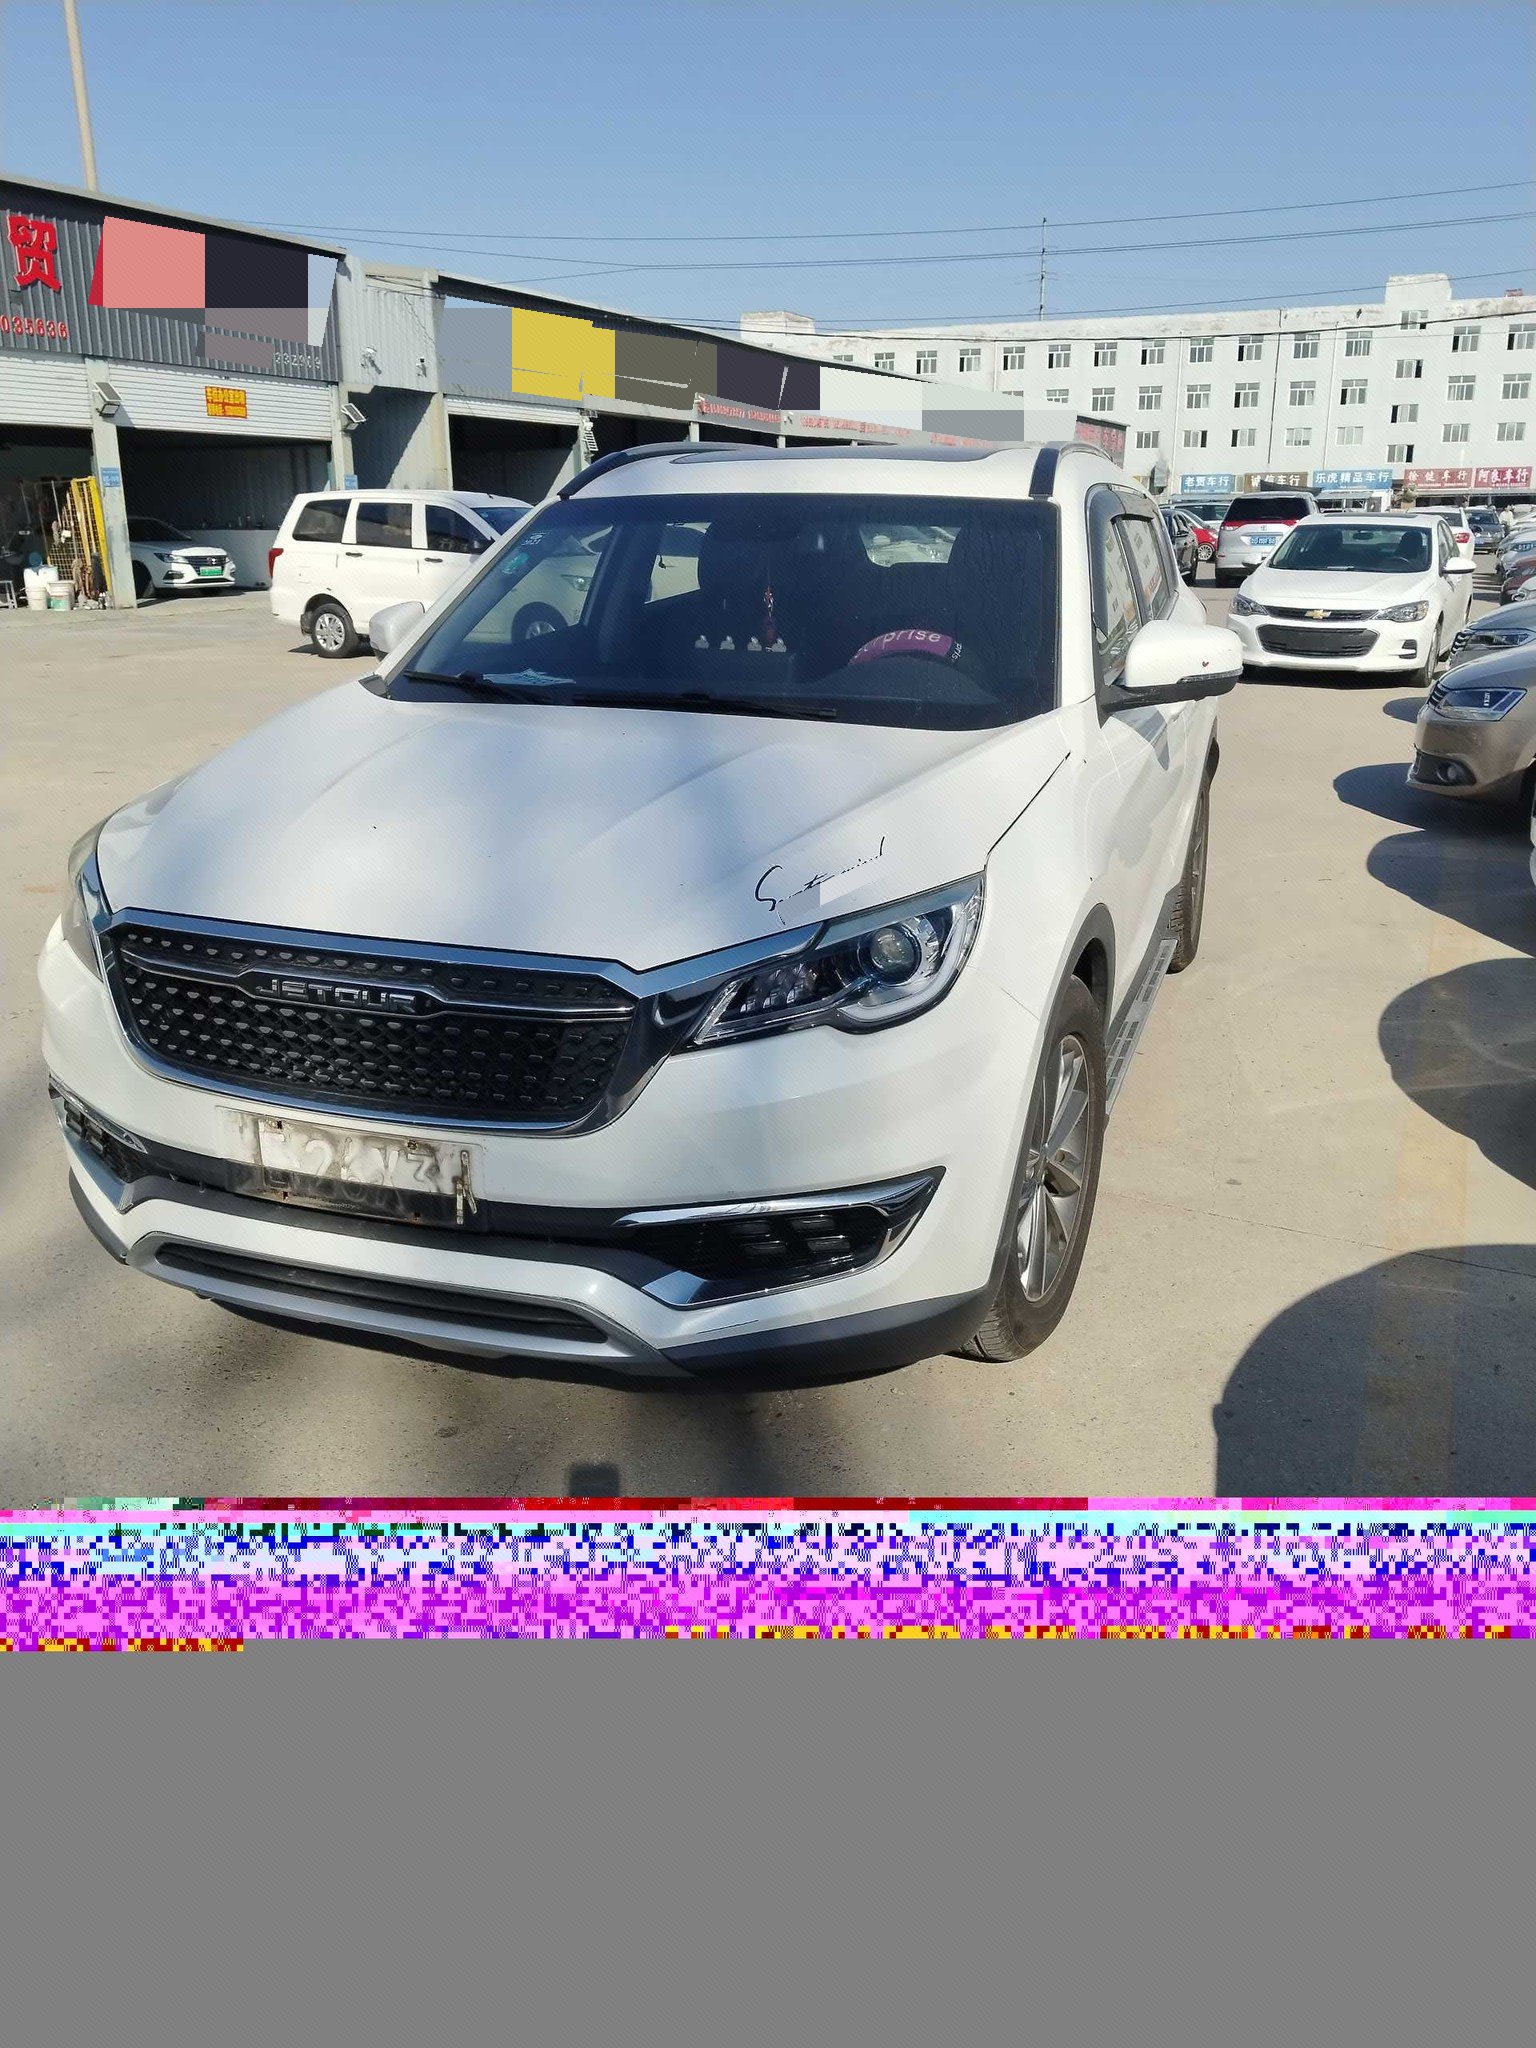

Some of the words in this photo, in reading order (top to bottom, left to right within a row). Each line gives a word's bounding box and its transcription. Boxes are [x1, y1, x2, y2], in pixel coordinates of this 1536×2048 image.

[7, 215, 62, 292] 贸
[1315, 471, 1389, 484] 乐虎精品车行
[255, 979, 417, 1014] JETOUR
